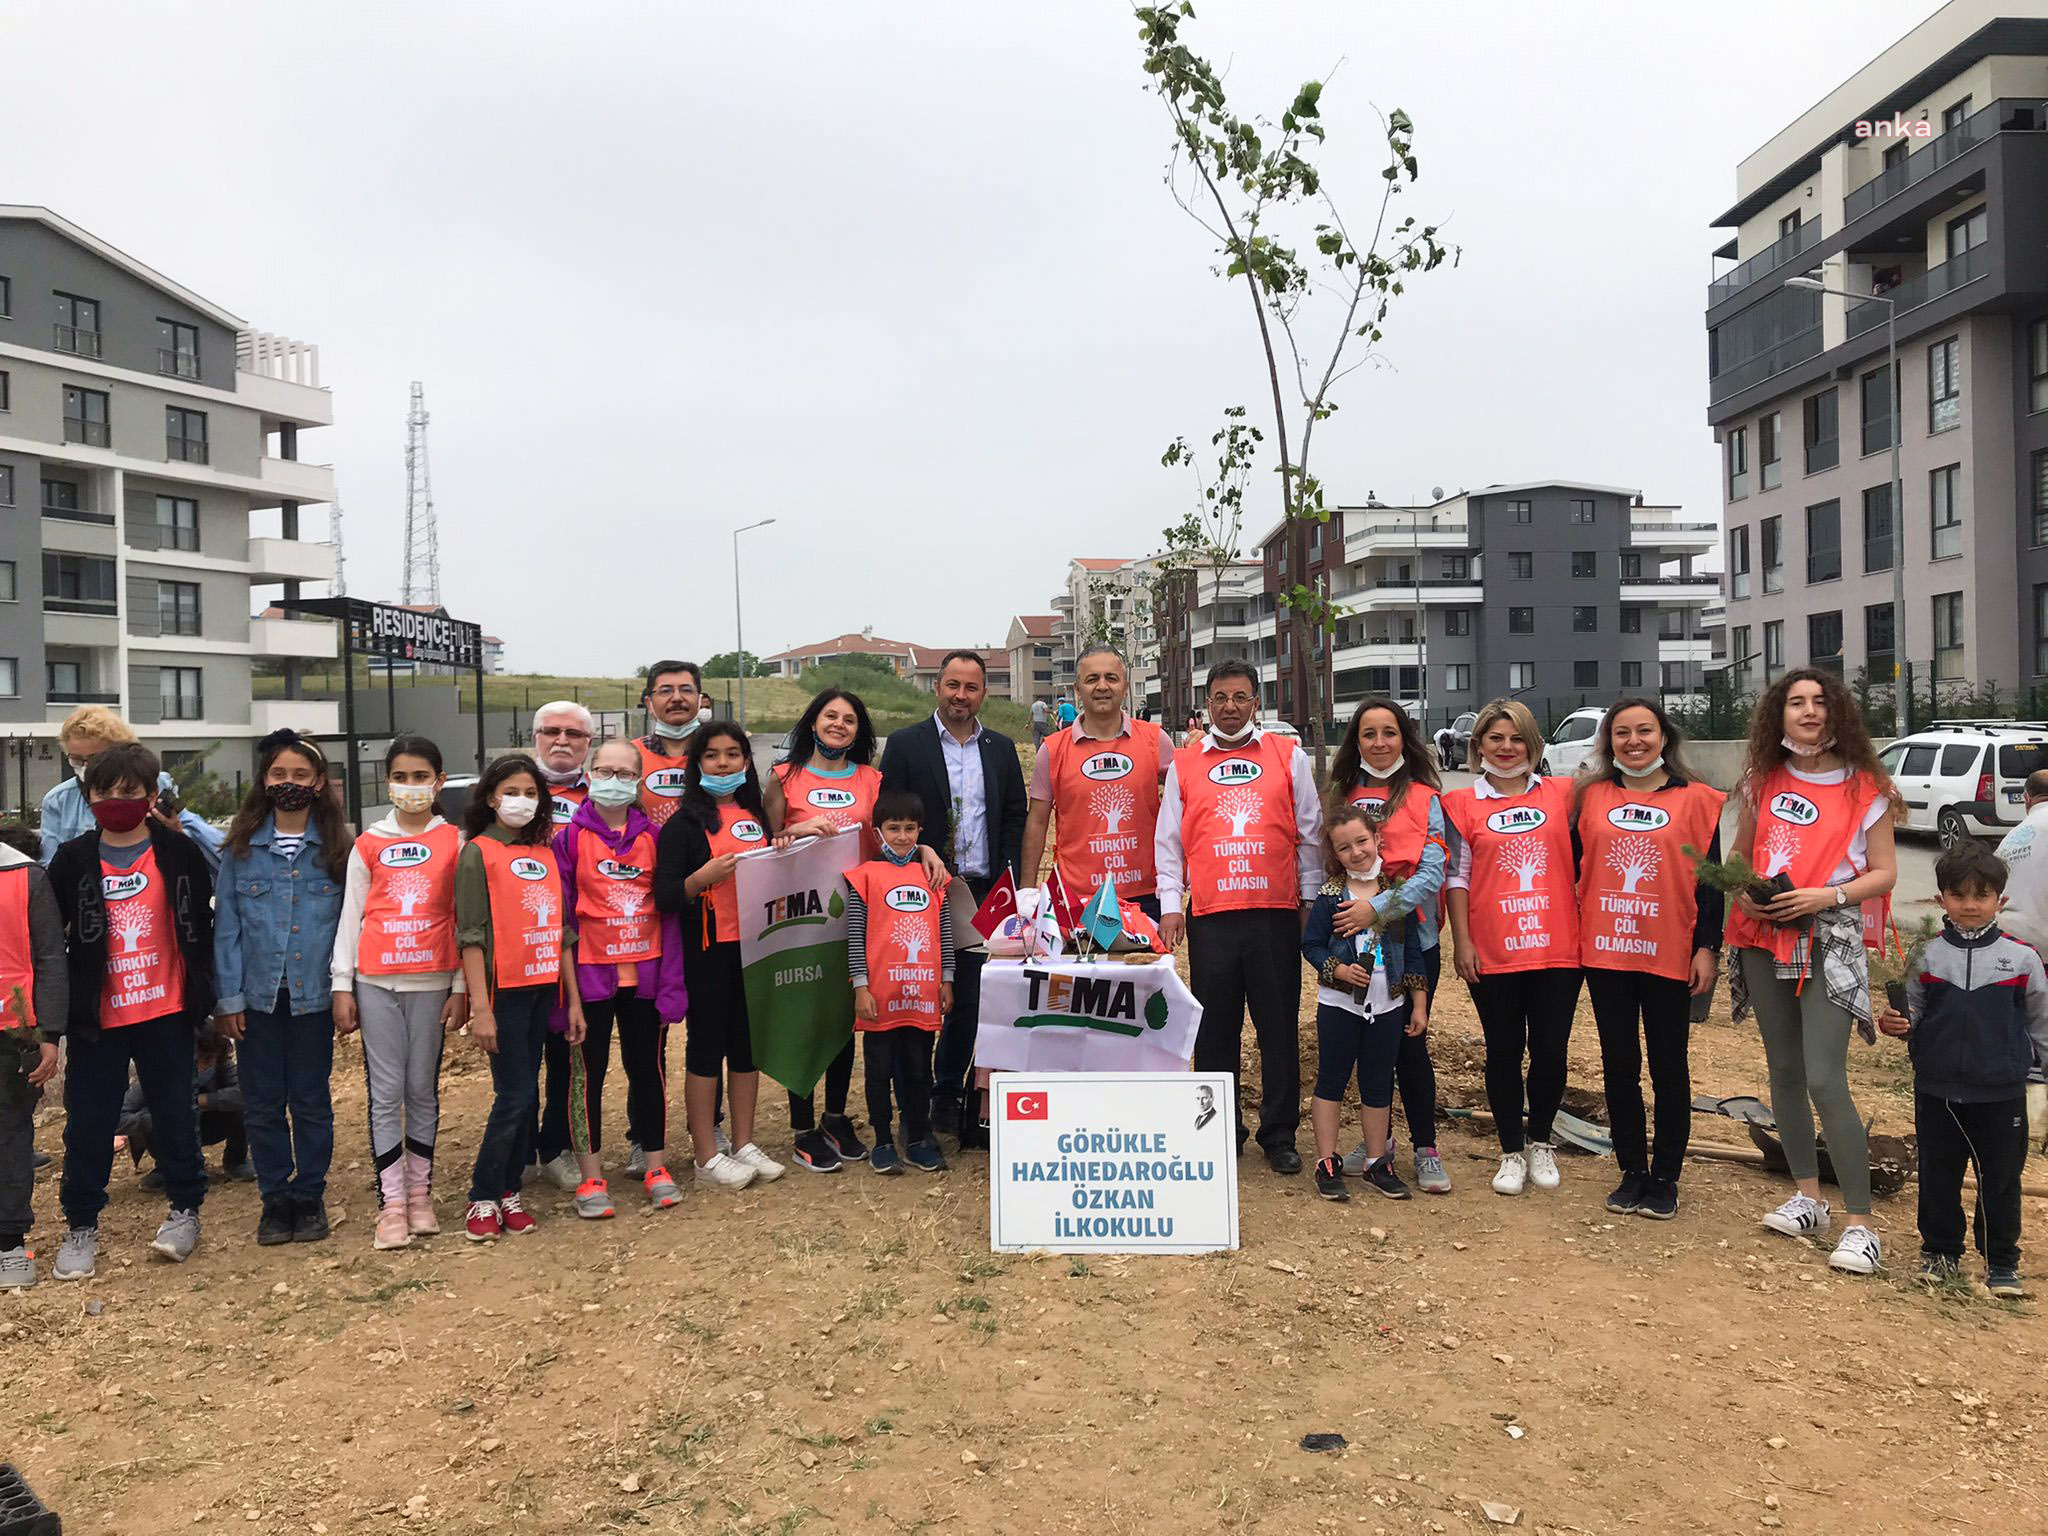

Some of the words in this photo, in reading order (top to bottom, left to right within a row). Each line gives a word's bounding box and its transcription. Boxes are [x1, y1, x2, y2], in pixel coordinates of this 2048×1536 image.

[373, 606, 450, 646] RESIDENCE
[1092, 757, 1119, 770] TEMA
[1219, 763, 1249, 776] TEMA
[657, 773, 685, 785] TEMA
[817, 792, 844, 801] TEMA
[1499, 810, 1532, 825] TEMA
[1622, 808, 1652, 821] TEMA
[738, 823, 756, 833] TEMA
[390, 847, 418, 859] TEMA
[1089, 836, 1138, 854] TÜRKİYE
[1213, 838, 1265, 857] TÜRKİYE
[1104, 855, 1127, 871] ÇÖL
[1229, 856, 1253, 876] ÇÖL
[106, 878, 134, 890] TEMA
[1217, 876, 1268, 892] OLMASIN
[896, 890, 921, 901] TEMA
[1499, 893, 1550, 914] TÜRKİYE
[764, 889, 823, 926] TEMA
[1599, 893, 1659, 917] TÜRKİYE
[383, 917, 432, 933] TÜRKİYE
[1518, 912, 1542, 934] ÇÖL
[1614, 915, 1640, 936] ÇÖL
[395, 933, 418, 951] ÇÖL
[522, 927, 560, 945] TÜRKİY
[619, 924, 640, 942] ÇÖL
[535, 943, 557, 961] ÇÖL
[1595, 934, 1657, 956] OLMASIN
[107, 952, 159, 974] TÜRKİYE
[382, 950, 432, 964] OLMASIN
[525, 959, 560, 976] OLMAS
[774, 964, 823, 987] BURSA
[888, 965, 934, 982] TÜRKİYE
[123, 970, 149, 991] ÇÖL
[111, 985, 165, 1008] OLMASIN
[902, 981, 923, 999] ÇÖL
[1023, 969, 1136, 1020] TEMA
[888, 999, 935, 1014] OLMASIN
[1057, 1127, 1167, 1153] GÖRÜKLE
[1012, 1155, 1214, 1182] HAZİNEDAROĞLU
[1072, 1184, 1154, 1210] ÖZKAN
[1055, 1211, 1174, 1237] İLKOKULU
